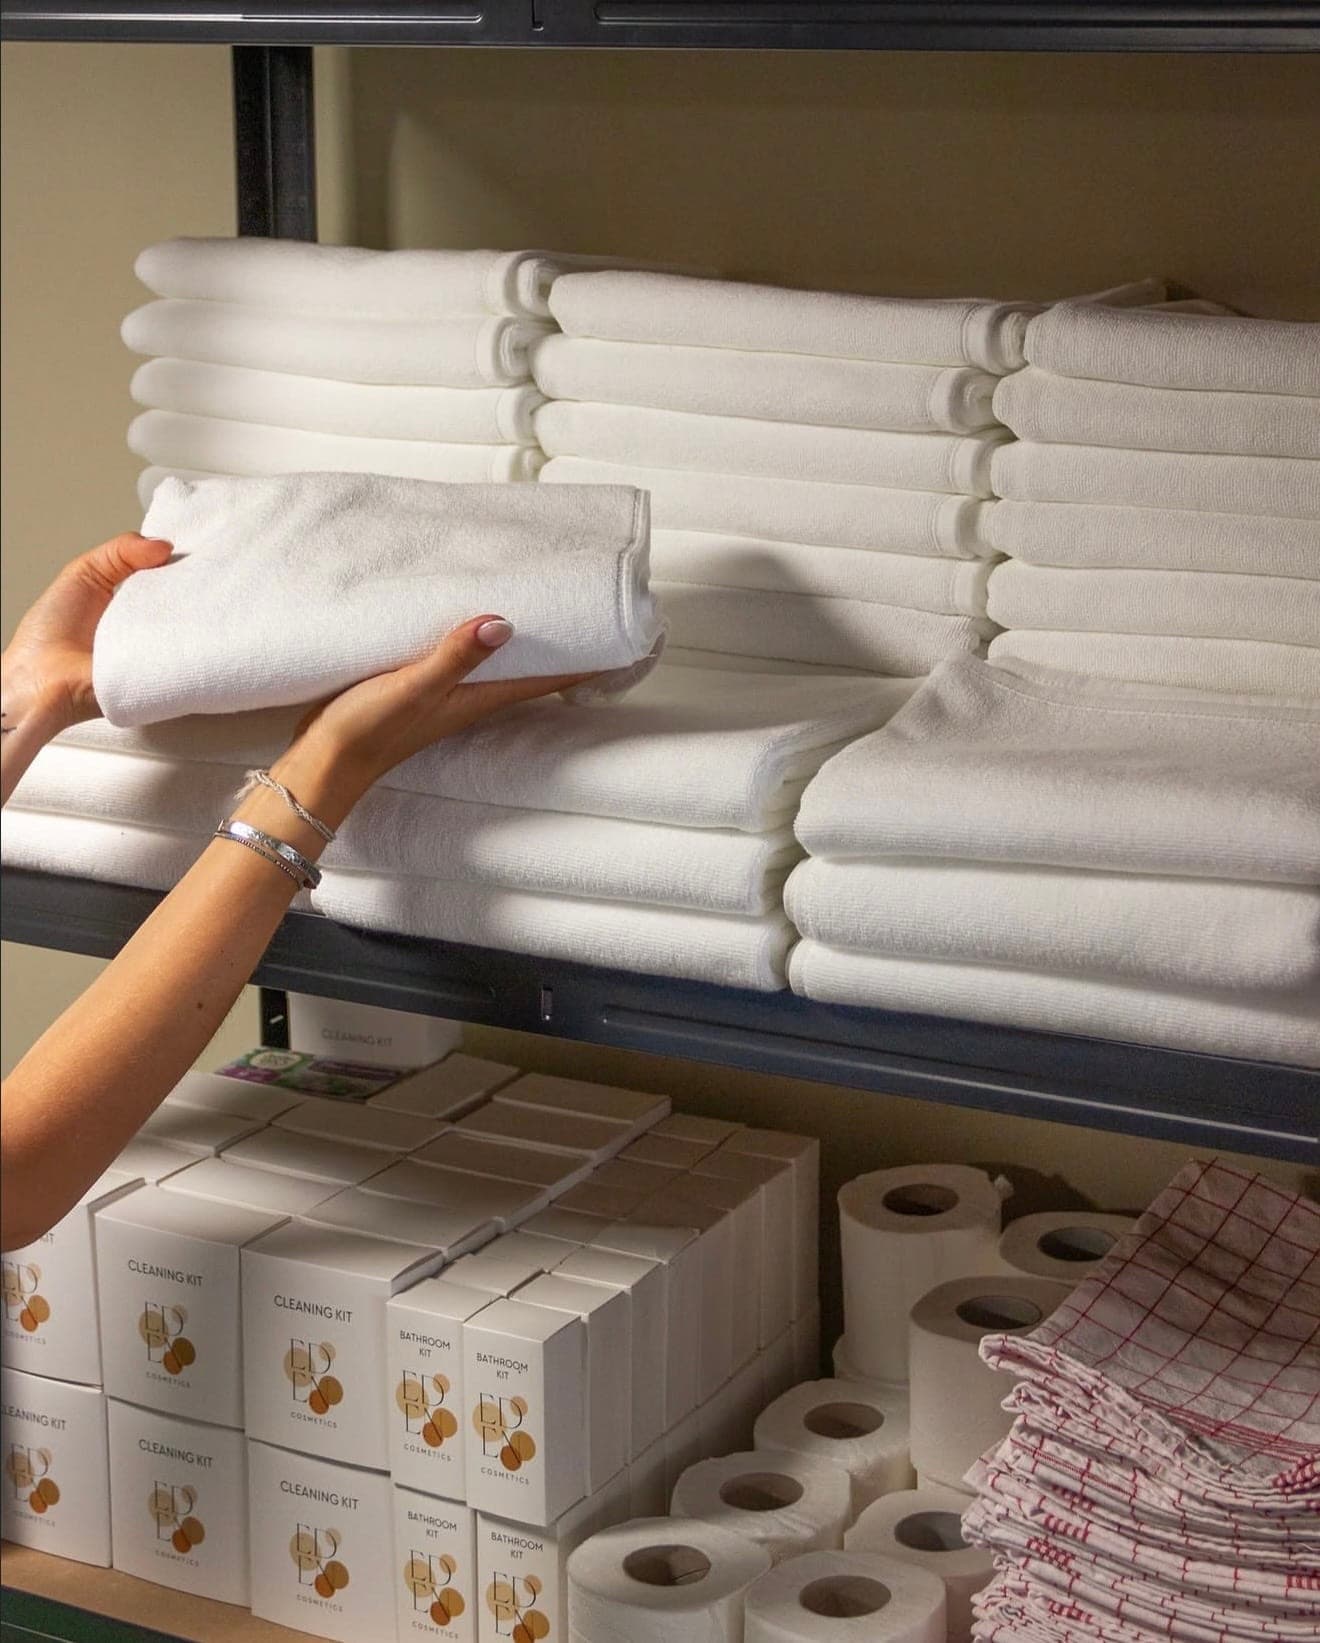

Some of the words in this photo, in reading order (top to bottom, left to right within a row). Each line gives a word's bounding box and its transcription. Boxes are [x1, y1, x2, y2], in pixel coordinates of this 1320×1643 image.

[321, 1029, 375, 1046] CLEANING
[376, 1037, 393, 1047] KIT
[128, 1259, 184, 1284] CLEANING
[186, 1274, 203, 1286] KIT
[274, 1295, 333, 1319] CLEANING
[335, 1310, 353, 1323] KIT
[400, 1330, 450, 1350] BATHROOM
[419, 1348, 432, 1358] KIT
[476, 1352, 528, 1372] BATHROOM
[496, 1370, 509, 1380] KIT
[1, 1403, 49, 1426] LEANING
[51, 1418, 66, 1430] KIT
[290, 1411, 338, 1429] COSMETICS
[138, 1439, 194, 1464] CLEANING
[196, 1455, 212, 1468] KIT
[404, 1443, 452, 1462] COSMETICS
[480, 1467, 530, 1485] COSMETICS
[280, 1480, 339, 1506] CLEANING
[341, 1496, 359, 1510] KIT
[408, 1511, 456, 1531] BATHROOM
[426, 1529, 438, 1539] KIT
[491, 1532, 544, 1552] BATHROOM
[510, 1550, 523, 1559] KIT
[412, 1620, 459, 1639] COSMETICS
